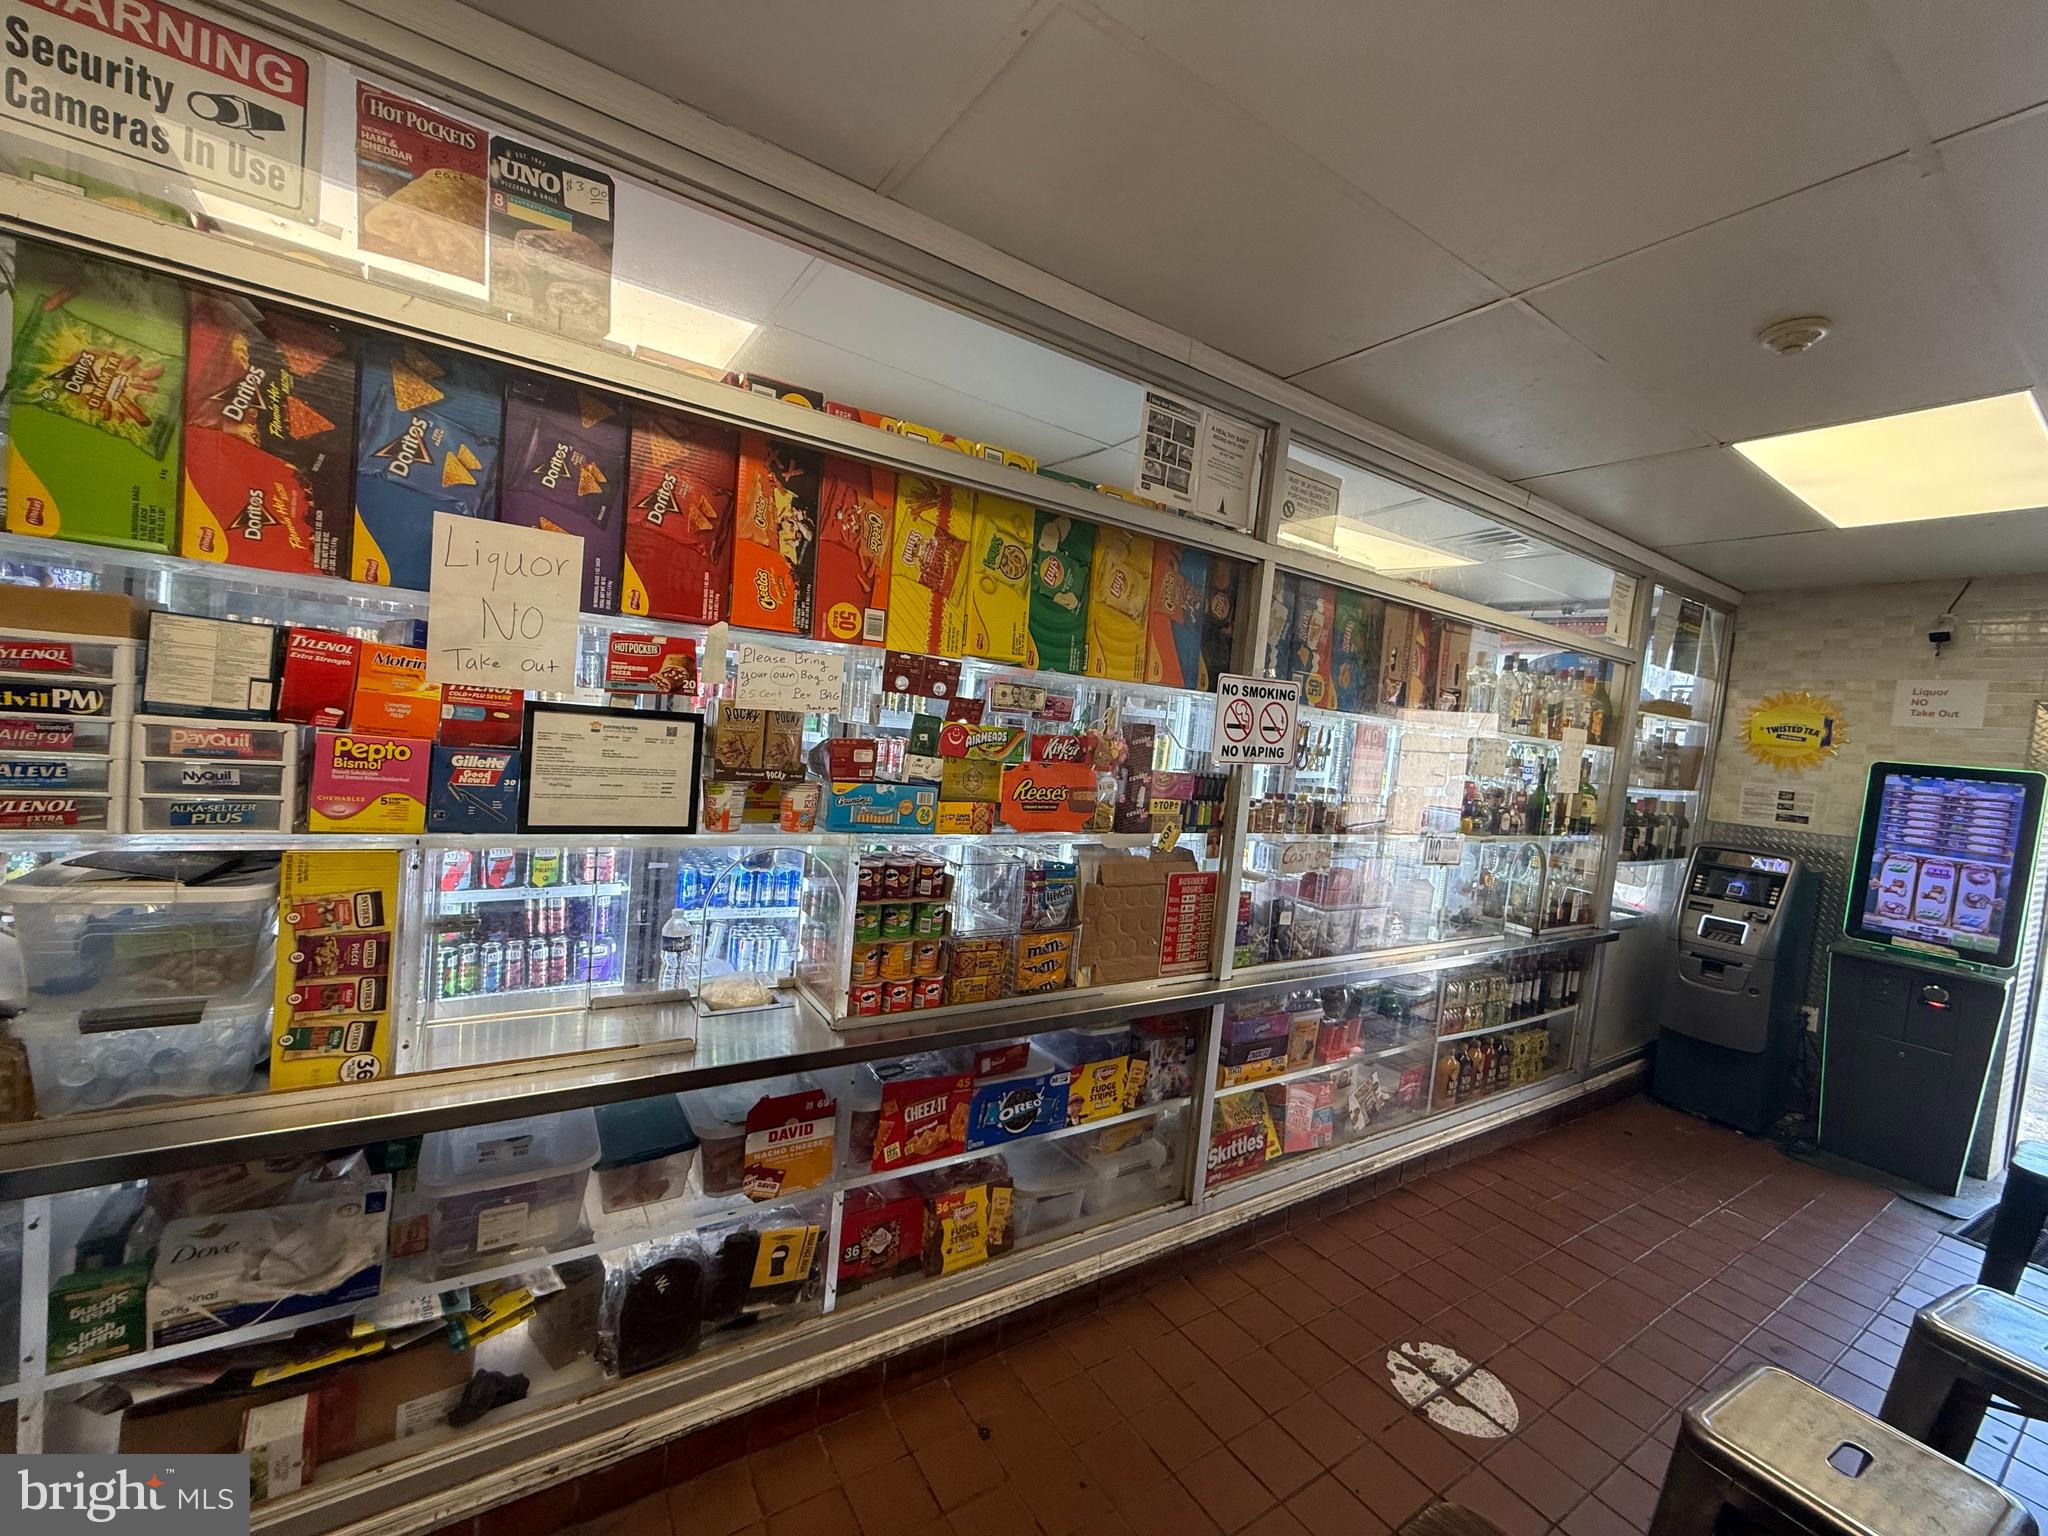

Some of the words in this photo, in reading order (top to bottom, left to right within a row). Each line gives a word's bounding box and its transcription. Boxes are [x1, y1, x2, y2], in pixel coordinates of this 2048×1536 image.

[25, 0, 294, 93] ARNING
[5, 15, 174, 114] Security
[5, 67, 170, 155] Cameras
[184, 127, 215, 170] In
[228, 141, 286, 192] Use
[370, 98, 404, 124] HOT
[407, 110, 476, 150] POCKETS
[361, 130, 387, 146] HAM
[389, 139, 398, 149] &
[361, 139, 413, 162] CHEDDAR
[498, 155, 561, 194] UNO
[494, 193, 503, 206] 8
[65, 351, 96, 393] Doritos
[222, 366, 266, 422] Doritos
[389, 416, 429, 477] Doritos
[541, 443, 570, 489] Doritos
[647, 472, 678, 526] Doritos
[243, 488, 264, 541] Doritos
[867, 511, 885, 553] Cheetos
[444, 525, 570, 591] Liquor
[755, 568, 777, 611] Cheetos
[482, 598, 544, 640] NO
[838, 611, 857, 632] 50
[0, 646, 68, 660] YLENOL
[291, 634, 353, 655] TYLENOL
[614, 642, 628, 652] HOT
[629, 643, 658, 654] POCKETS
[290, 651, 313, 661] Extra
[314, 654, 351, 666] Strength
[373, 652, 426, 670] Motrin
[442, 648, 502, 671] Take
[740, 647, 786, 665] Please
[794, 654, 829, 672] Bring
[683, 680, 696, 689] 20
[740, 670, 767, 687] your
[800, 670, 824, 685] Bag
[52, 688, 98, 709] PM
[739, 690, 756, 699] 25
[792, 688, 810, 700] Per
[819, 690, 840, 700] BAG
[1222, 683, 1239, 696] NO
[1241, 685, 1296, 701] SMOKING
[1912, 687, 1949, 697] Liquor
[724, 706, 760, 723] POCKY
[775, 711, 802, 726] POCKY
[1911, 709, 1935, 718] Take
[1938, 710, 1960, 718] Out
[0, 729, 73, 744] Allergy
[171, 730, 250, 748] DayQuil
[965, 731, 1007, 748] AIRHEADS
[1765, 726, 1803, 734] TWISTED
[1804, 728, 1820, 737] TEA
[334, 736, 411, 762] Pepto
[1221, 745, 1239, 757] NO
[1243, 746, 1284, 758] VAPING
[0, 763, 67, 777] ALEVE
[333, 757, 382, 771] Bismol
[451, 755, 506, 768] Gillette
[182, 770, 231, 783] NyQuil
[458, 776, 490, 784] News!
[463, 770, 492, 779] Good
[765, 770, 787, 780] POCKY
[170, 803, 256, 813] ALKA-SELTZER
[380, 797, 387, 805] 5
[1158, 801, 1173, 810] TOP
[27, 814, 64, 822] EXTRA
[191, 813, 242, 824] PLUS
[920, 809, 931, 818] 24
[1159, 826, 1173, 844] TOP
[1427, 839, 1442, 861] NO
[1751, 857, 1790, 873] ATM
[1178, 876, 1208, 885] BUSINESS
[1046, 886, 1073, 902] Welch's
[350, 942, 360, 967] PIECES
[291, 995, 299, 1003] 9
[282, 1036, 290, 1044] 9
[356, 1057, 375, 1081] 36
[956, 1078, 971, 1089] 45
[1091, 1082, 1117, 1095] FUDGE
[1320, 1086, 1330, 1095] 24
[1089, 1090, 1117, 1102] STRIPES
[999, 1099, 1042, 1121] OREO
[768, 1123, 814, 1143] DAVID
[753, 1147, 787, 1160] NACHO
[789, 1140, 823, 1152] CHEESE
[1207, 1134, 1264, 1169] Skittles
[757, 1181, 777, 1190] DAVID
[936, 1202, 949, 1215] 36
[950, 1229, 980, 1246] STRIPES
[951, 1221, 979, 1237] FUDGE
[170, 1241, 240, 1265] Dove
[844, 1245, 860, 1260] 36
[66, 1324, 127, 1356] Spring
[79, 1321, 116, 1343] Irish
